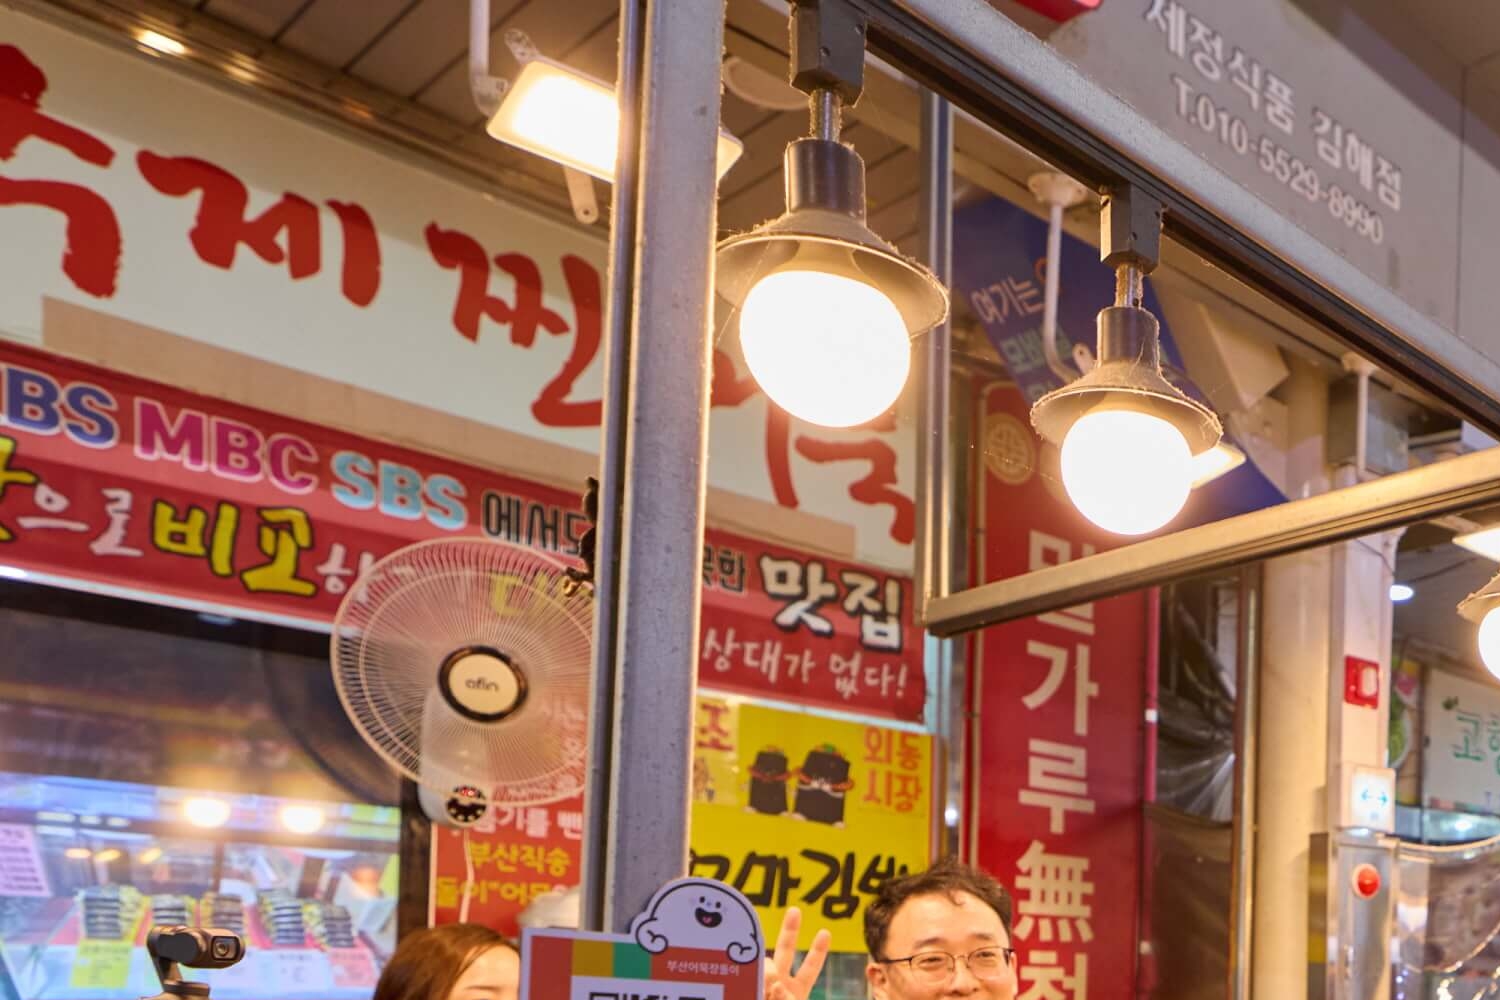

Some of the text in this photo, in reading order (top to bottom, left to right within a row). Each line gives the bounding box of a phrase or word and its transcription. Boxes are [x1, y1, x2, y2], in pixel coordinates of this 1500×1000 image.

[1146, 0, 1402, 211] 세정식품 김해점
[1171, 73, 1384, 244] T.010-5529-8990
[0, 362, 119, 448] BS
[134, 397, 319, 494] MBC
[331, 451, 468, 530] SBS
[759, 554, 904, 654] 맛집
[701, 627, 815, 684] 상대가
[829, 653, 908, 699] 없다!
[864, 727, 922, 771] 외동
[863, 769, 922, 813] 시장
[666, 960, 740, 976] 부산어묵장돌이
